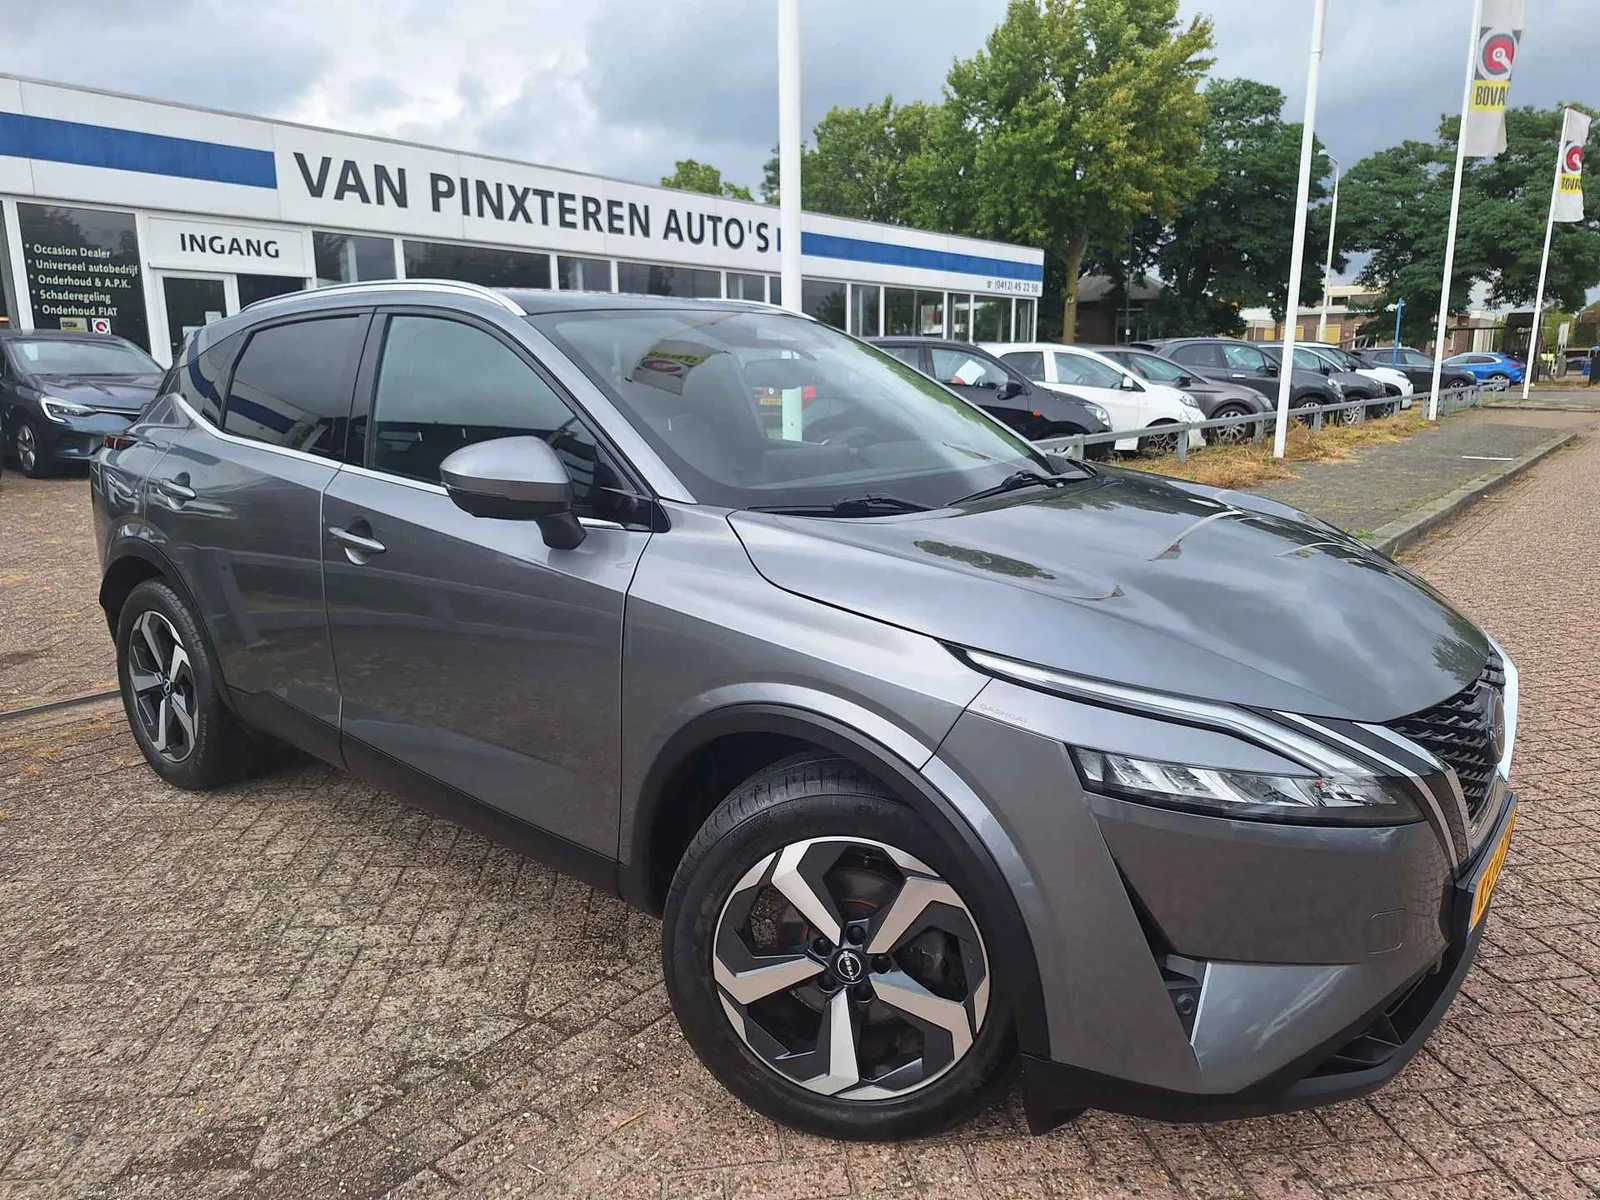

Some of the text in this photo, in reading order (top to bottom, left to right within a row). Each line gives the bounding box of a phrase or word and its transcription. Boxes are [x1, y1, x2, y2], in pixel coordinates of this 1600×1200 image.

[1475, 85, 1509, 106] BOVA
[1561, 176, 1583, 190] BOVA
[293, 152, 770, 253] VAN PINXTEREN AUTO'S
[33, 244, 111, 258] Occasion Dealer
[180, 233, 280, 258] INGANG
[35, 260, 138, 277] Universeel autobedrijf
[38, 275, 131, 288] Onderhoud & A.P.K.
[40, 290, 111, 304] Schaderegeling
[42, 305, 118, 316] Onderhoud FIAT
